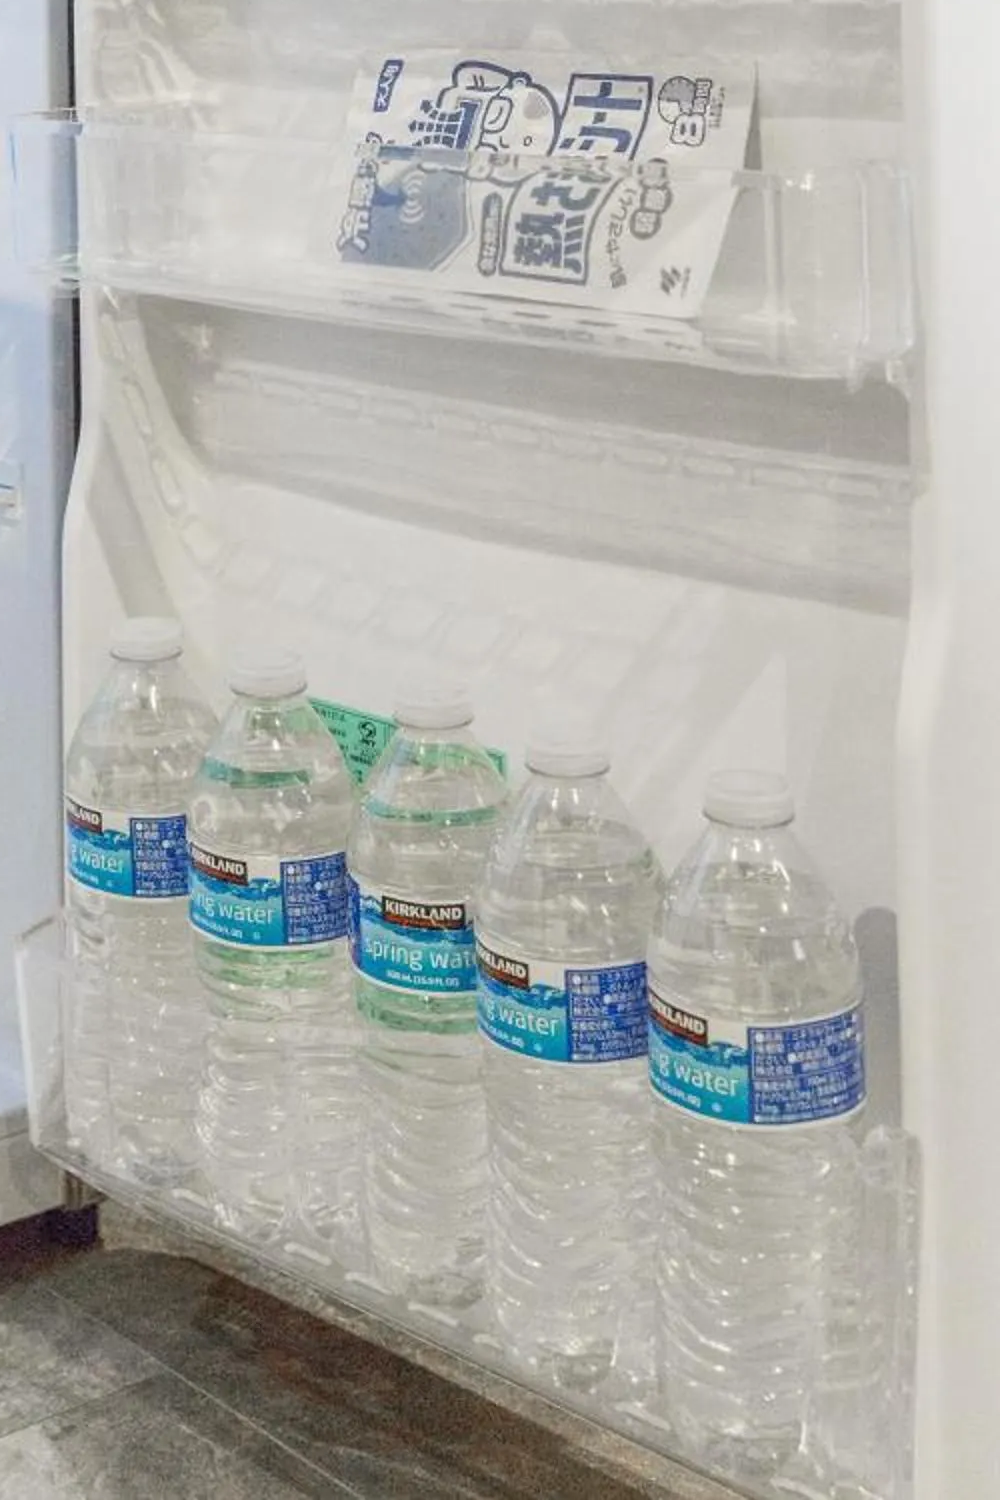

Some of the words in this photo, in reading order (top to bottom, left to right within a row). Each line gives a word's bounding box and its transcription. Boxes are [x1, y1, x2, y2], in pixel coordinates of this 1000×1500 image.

[80, 848, 124, 874] water
[218, 899, 275, 924] water
[384, 898, 463, 922] KIRKLAND
[498, 1007, 560, 1038] water
[673, 1058, 740, 1097] water
